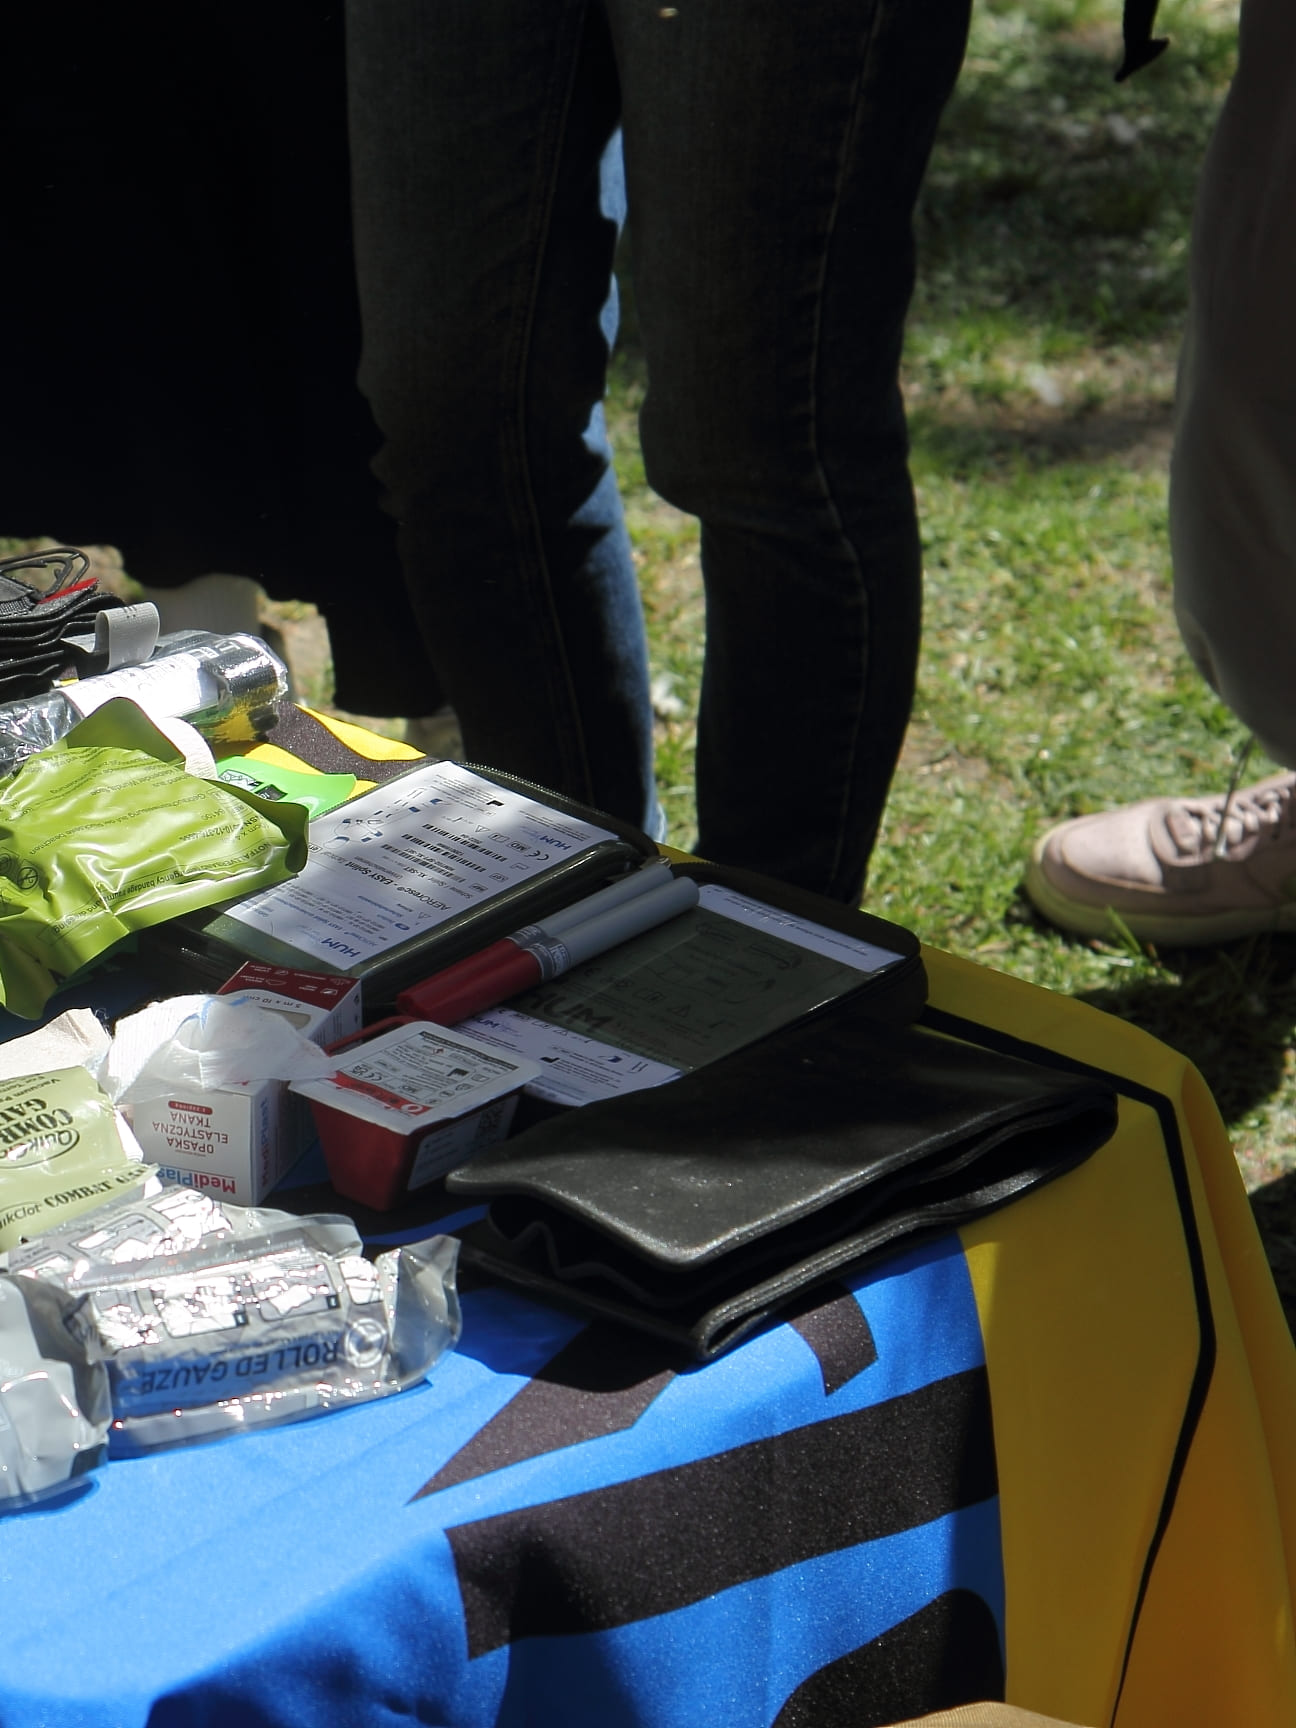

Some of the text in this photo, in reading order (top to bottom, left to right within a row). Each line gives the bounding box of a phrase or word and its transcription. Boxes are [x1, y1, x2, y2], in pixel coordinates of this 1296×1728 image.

[345, 859, 370, 877] Splint
[125, 878, 156, 896] bandage
[368, 870, 394, 887] EASY
[320, 934, 361, 961] HUM
[13, 1077, 60, 1100] Vacuum
[170, 1111, 211, 1127] TKANA
[152, 1120, 229, 1143] ELASTYCZNA
[166, 1136, 214, 1153] OPASKA
[43, 1178, 113, 1210] COMBAT
[140, 1341, 339, 1395] ROLLED GAUZE
